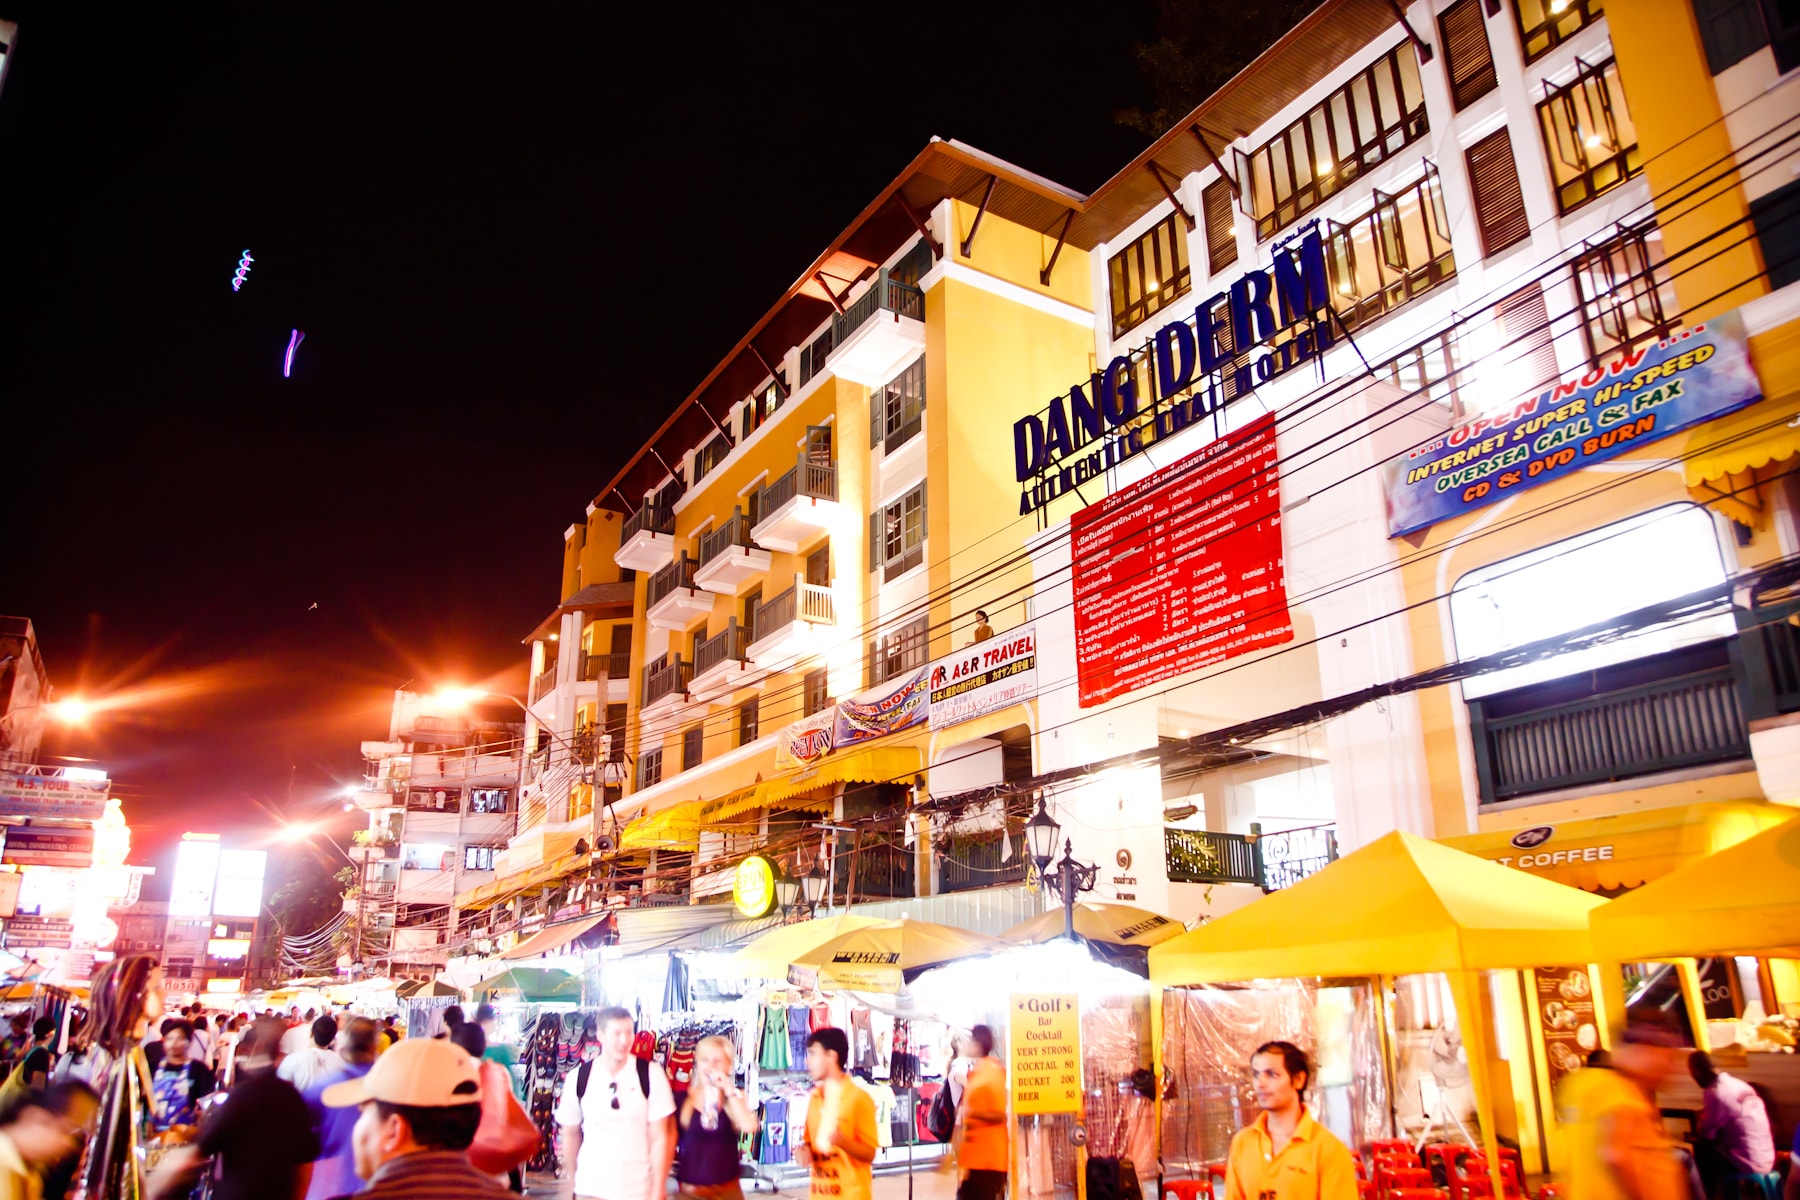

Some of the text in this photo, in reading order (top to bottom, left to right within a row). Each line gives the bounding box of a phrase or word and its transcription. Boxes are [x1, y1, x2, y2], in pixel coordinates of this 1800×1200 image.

[1013, 229, 1330, 482] DANG DERM
[1019, 427, 1143, 515] AUTHENTIC
[1156, 382, 1218, 439] THAI
[1235, 320, 1336, 394] HOTEL
[1407, 343, 1716, 485] INTERNET SUPER HI-SPEED
[1435, 380, 1684, 494] OVERSEA CALL & FAX
[1463, 415, 1655, 503] CD & DVD BURN
[952, 656, 980, 680] A&R
[983, 636, 1034, 668] TRAVEL
[880, 682, 915, 710] NOW
[43, 780, 70, 791] TOUR
[1519, 846, 1614, 868] COFFEE
[10, 923, 73, 931] INTERNET
[426, 996, 457, 1009] MASSAGE
[1028, 998, 1062, 1012] Golf
[1038, 1017, 1052, 1026] Bar
[1026, 1030, 1062, 1041] Cocktail
[1017, 1046, 1073, 1056] VERY STRONG
[1018, 1060, 1074, 1071] COCKTAIL 80
[1018, 1075, 1075, 1086] BUCKET 200
[1018, 1092, 1039, 1101] BEER
